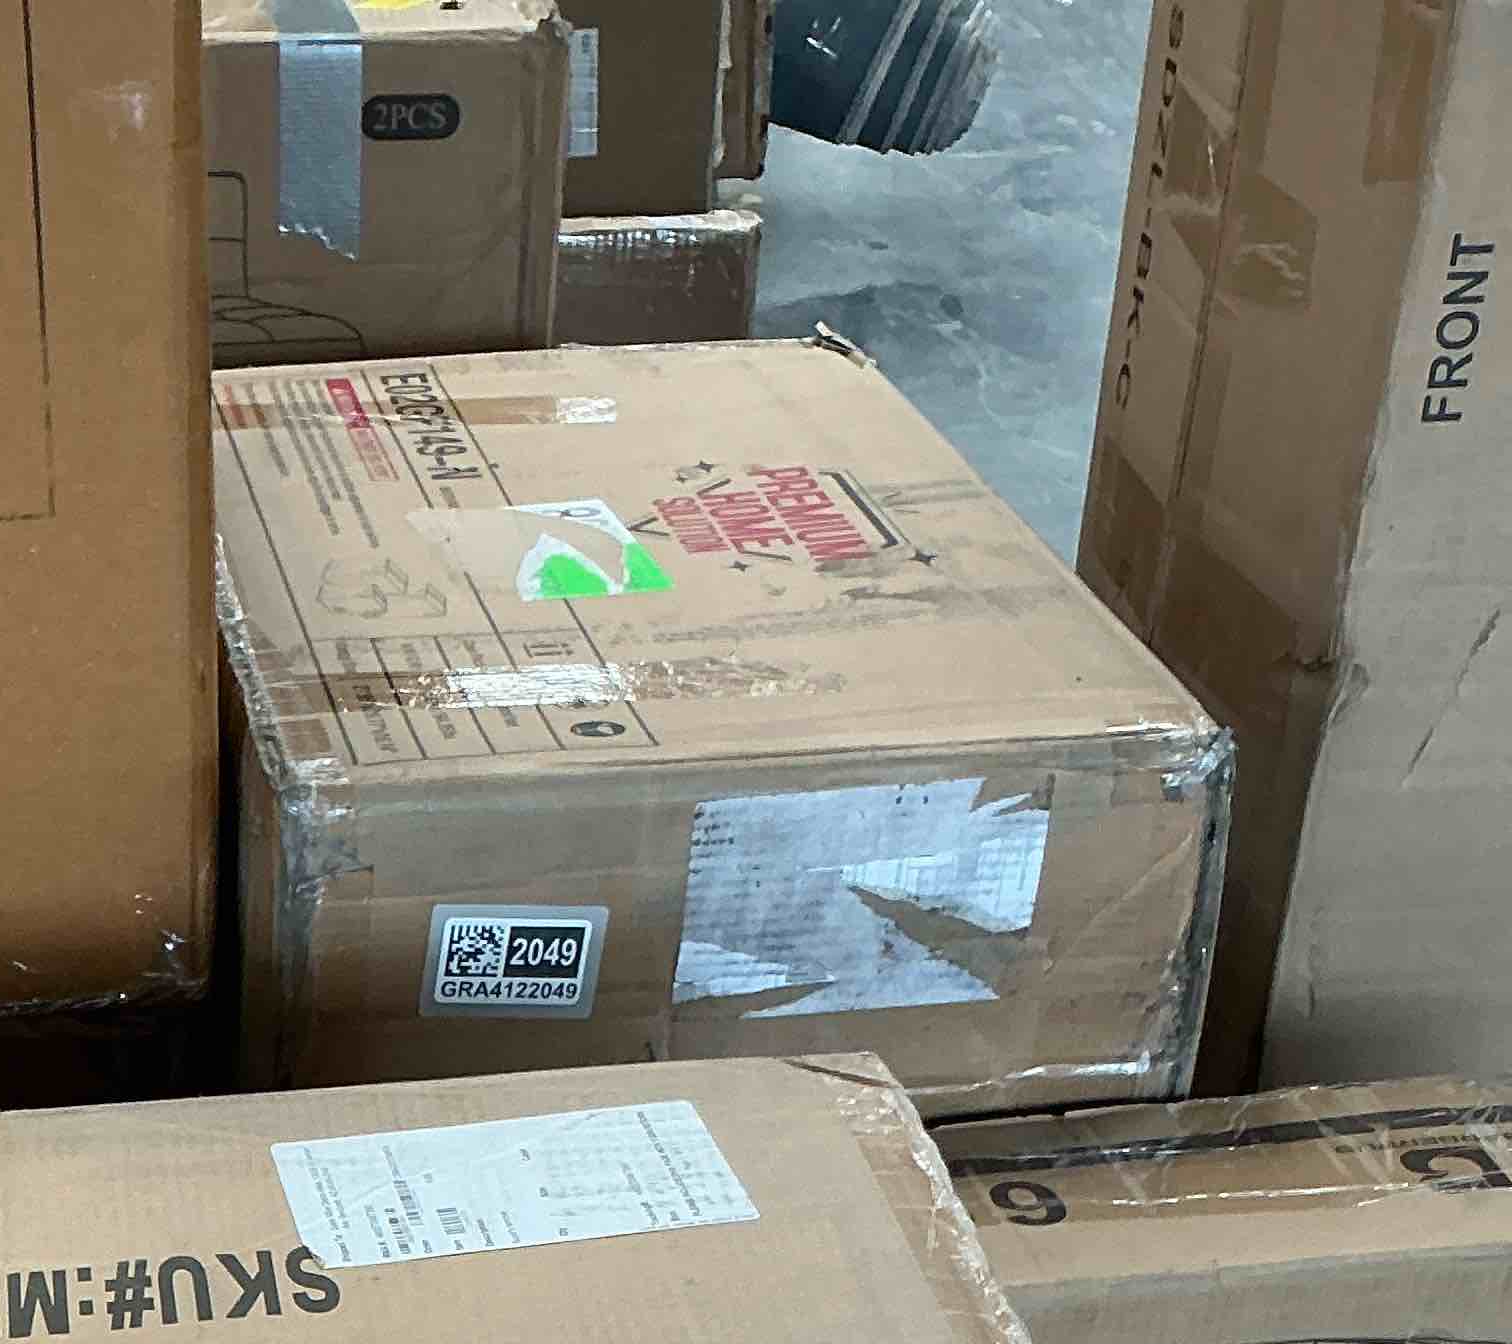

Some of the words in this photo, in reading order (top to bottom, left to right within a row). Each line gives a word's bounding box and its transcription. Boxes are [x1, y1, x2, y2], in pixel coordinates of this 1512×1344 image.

[372, 101, 449, 131] 2PCS
[1420, 232, 1495, 425] FRONT
[696, 489, 795, 552] HOME
[508, 937, 578, 967] 2049
[440, 980, 579, 1000] GRA4122049
